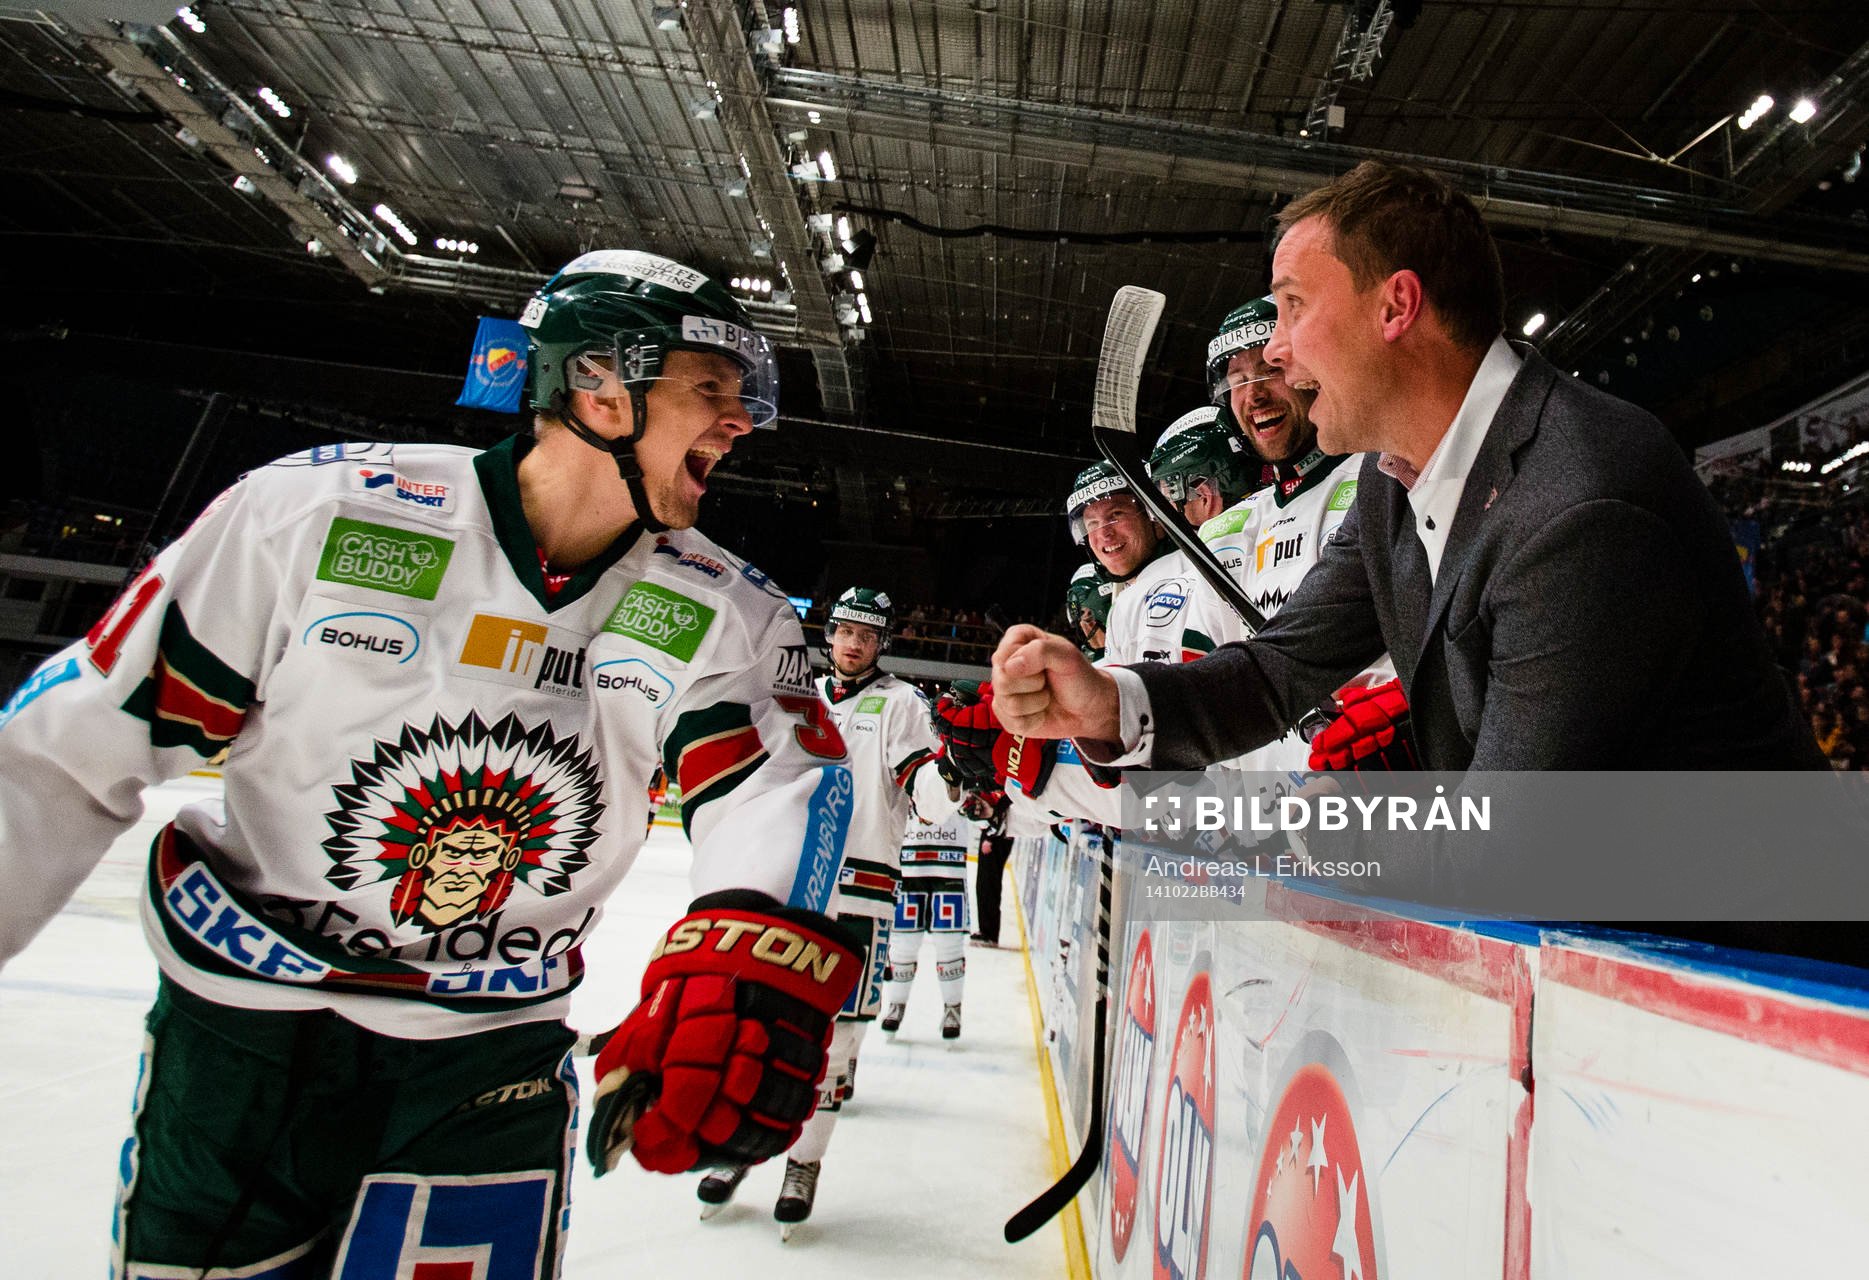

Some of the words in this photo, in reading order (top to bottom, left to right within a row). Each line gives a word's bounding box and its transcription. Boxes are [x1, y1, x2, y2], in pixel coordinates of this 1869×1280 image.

[1213, 321, 1277, 352] BJURFOR
[396, 477, 446, 497] INTER
[396, 487, 446, 508] SPORT
[1069, 476, 1123, 506] BJURFORS
[342, 537, 407, 563] CASH
[681, 552, 728, 573] INTER
[1222, 557, 1243, 570] HUS
[336, 553, 419, 585] BUDDY
[677, 560, 722, 579] SPORT
[623, 594, 672, 621] CASH
[842, 609, 885, 625] BJURFORS
[614, 609, 678, 645] BUDDY
[320, 627, 404, 656] BOHUS
[597, 673, 660, 702] BOHUS
[168, 868, 325, 978] SKF
